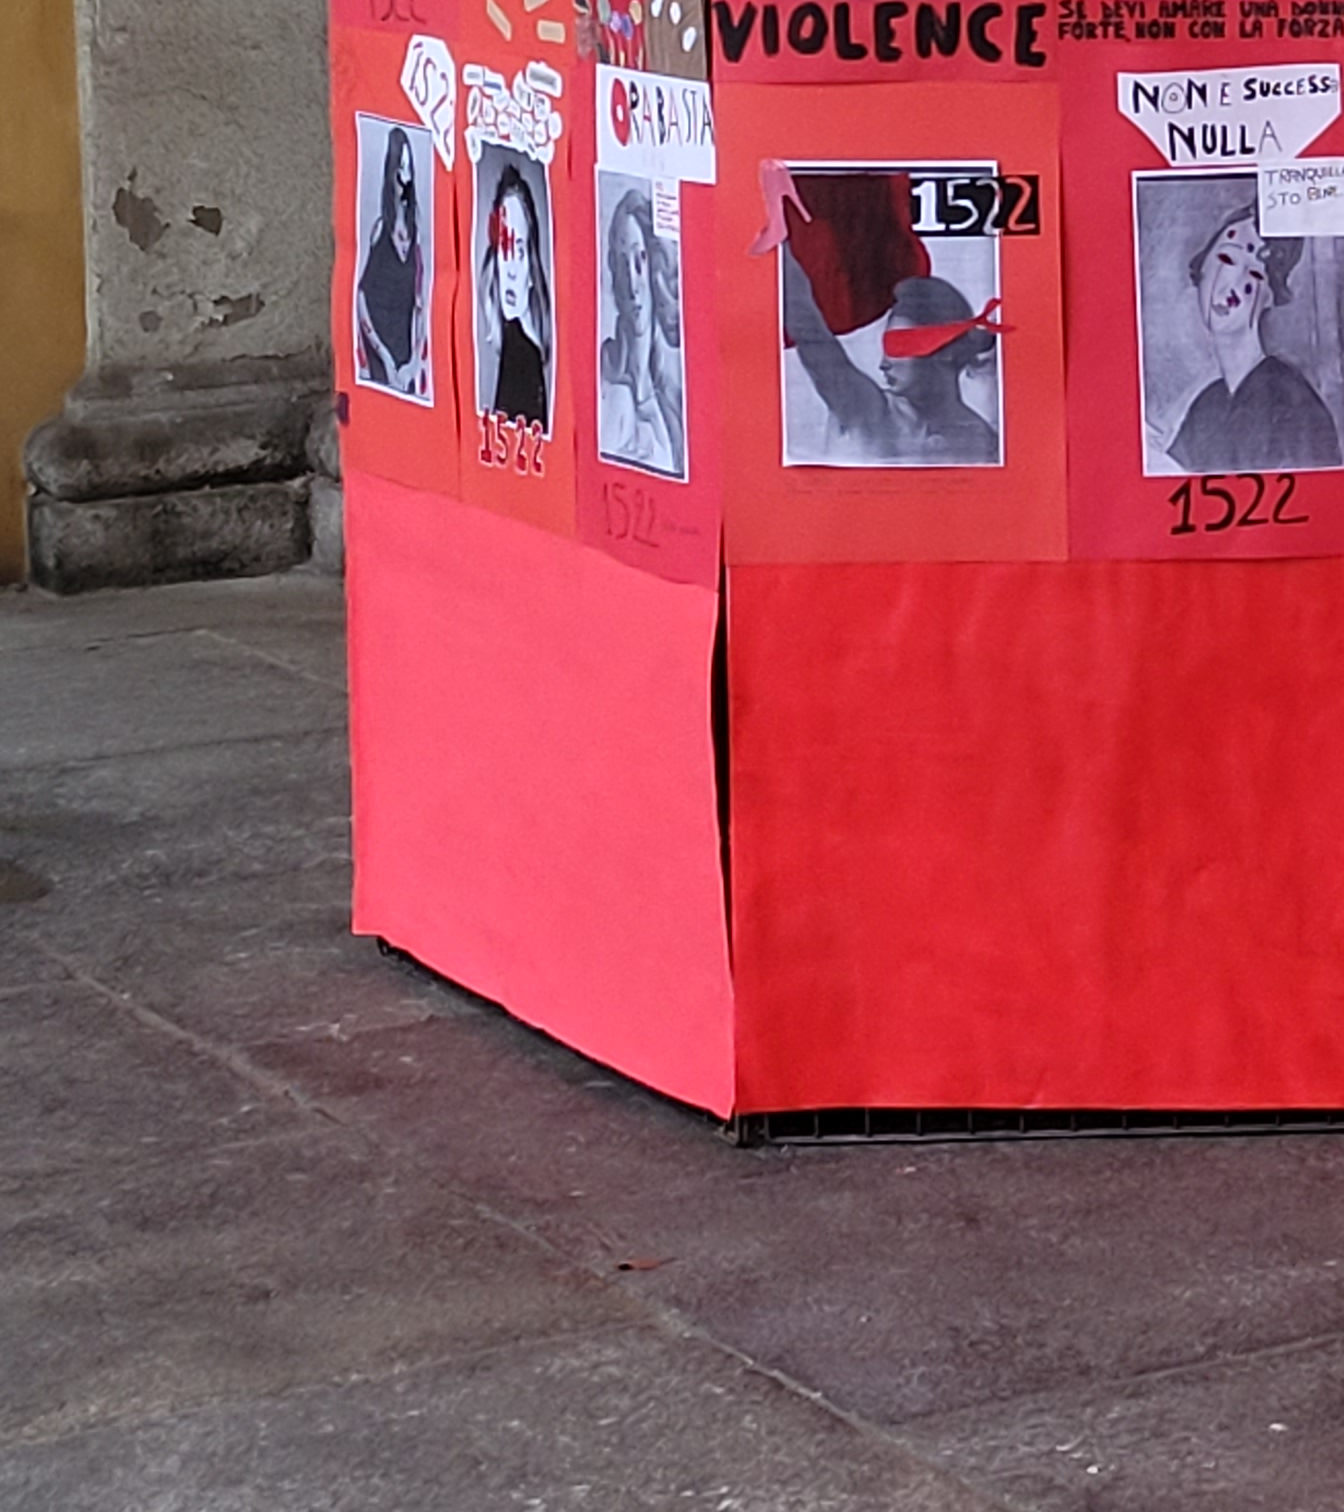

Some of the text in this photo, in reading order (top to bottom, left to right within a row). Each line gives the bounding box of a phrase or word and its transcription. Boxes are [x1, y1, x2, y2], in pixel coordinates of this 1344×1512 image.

[1058, 0, 1087, 19] SE
[1101, 0, 1146, 19] DEVI
[1158, 0, 1227, 19] AMARE
[1135, 19, 1176, 38] NON
[1188, 19, 1230, 39] CON
[1239, 18, 1264, 38] LA
[1277, 17, 1344, 39] FORZA
[1131, 77, 1208, 115] NON
[1166, 119, 1283, 162] NULLA
[910, 175, 1037, 238] 1522
[1267, 190, 1302, 209] STO
[478, 408, 546, 475] 1522
[1166, 472, 1310, 536] 1522
